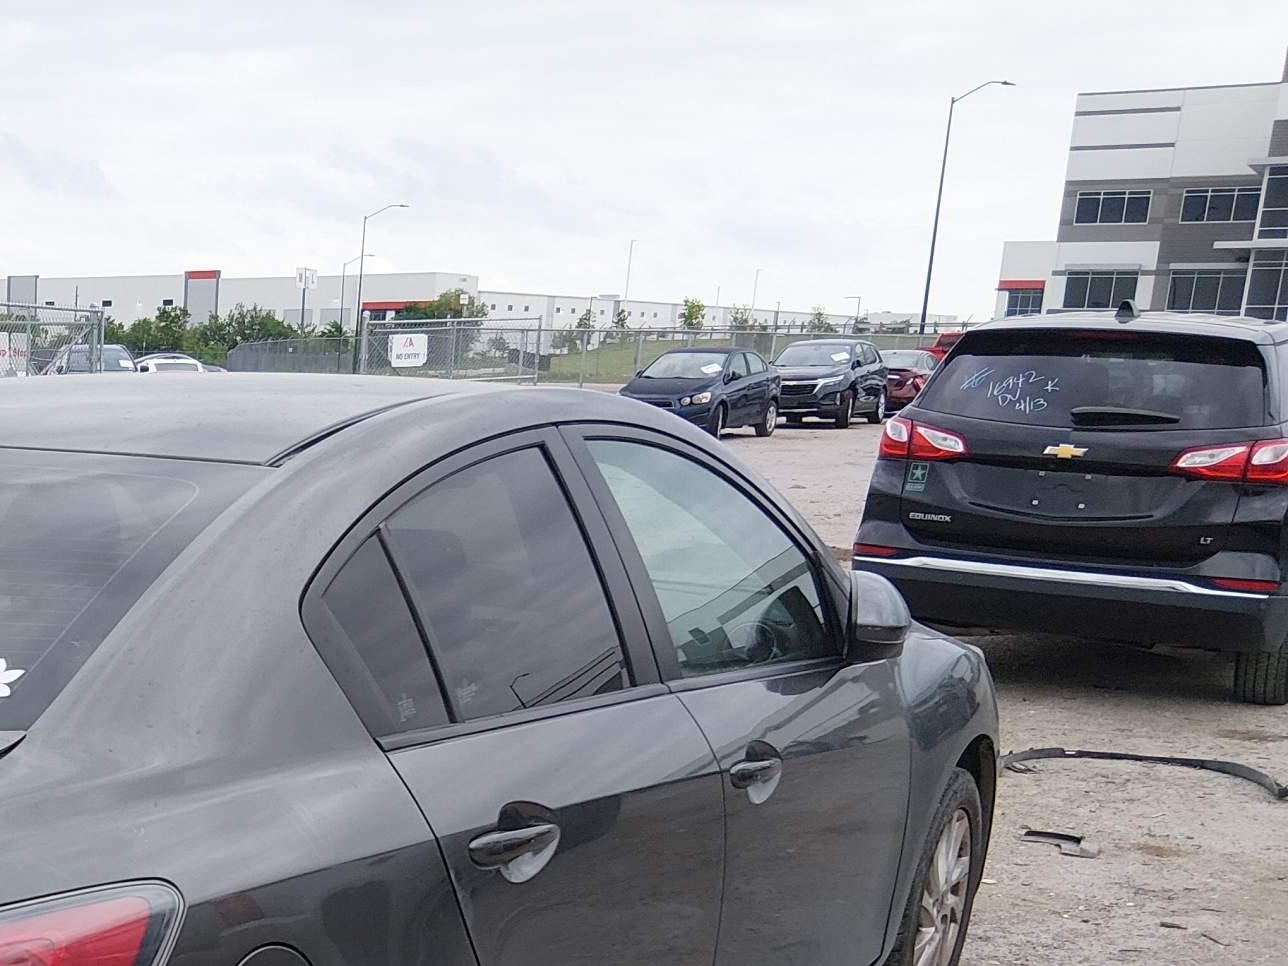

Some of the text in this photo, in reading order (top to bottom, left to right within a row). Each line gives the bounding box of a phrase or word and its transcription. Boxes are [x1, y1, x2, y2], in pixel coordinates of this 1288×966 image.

[404, 352, 420, 360] ENTRY
[909, 512, 952, 523] EQUINOX
[1199, 536, 1214, 545] LT
